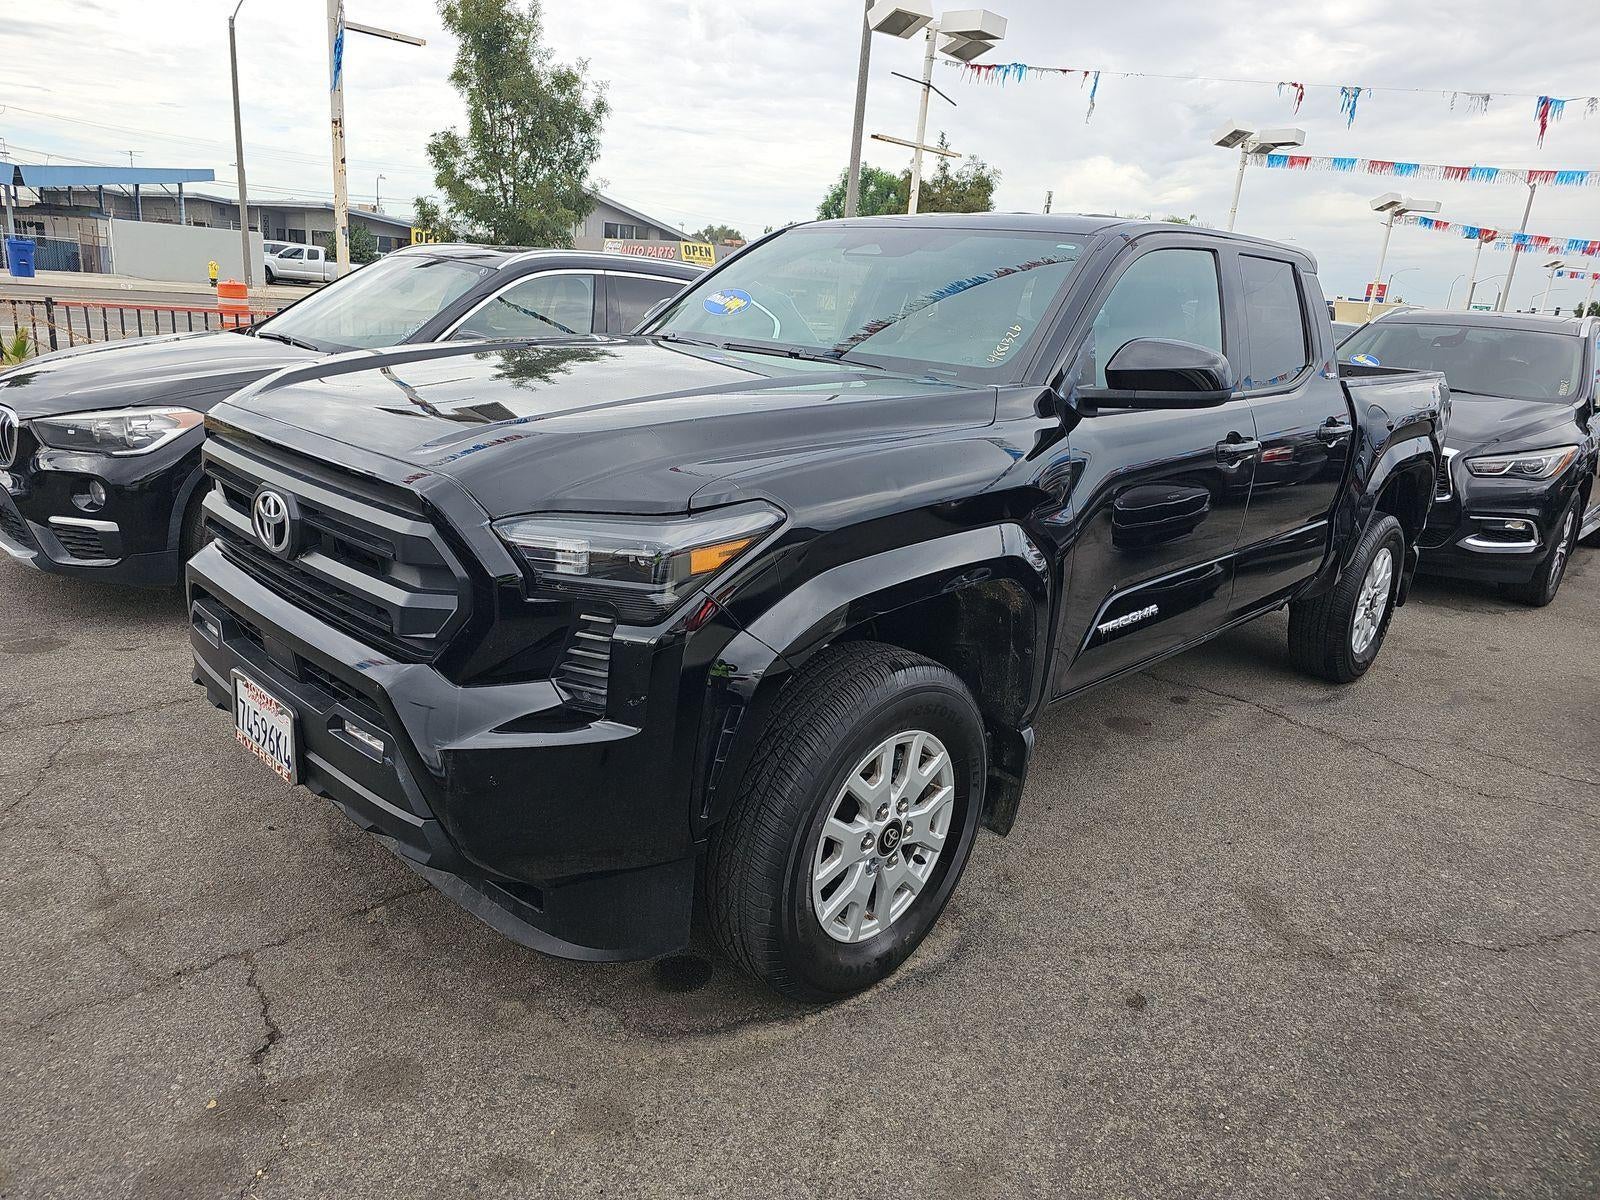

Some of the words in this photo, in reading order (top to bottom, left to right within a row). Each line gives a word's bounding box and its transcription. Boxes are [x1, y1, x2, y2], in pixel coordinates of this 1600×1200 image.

[621, 244, 645, 256] AUTO
[646, 246, 677, 259] PARTS
[684, 244, 712, 257] OPEN
[1097, 604, 1159, 634] TACOMA
[247, 680, 281, 709] TOYOTA
[239, 698, 291, 771] 74596K4
[235, 728, 292, 784] RIVERSIDE
